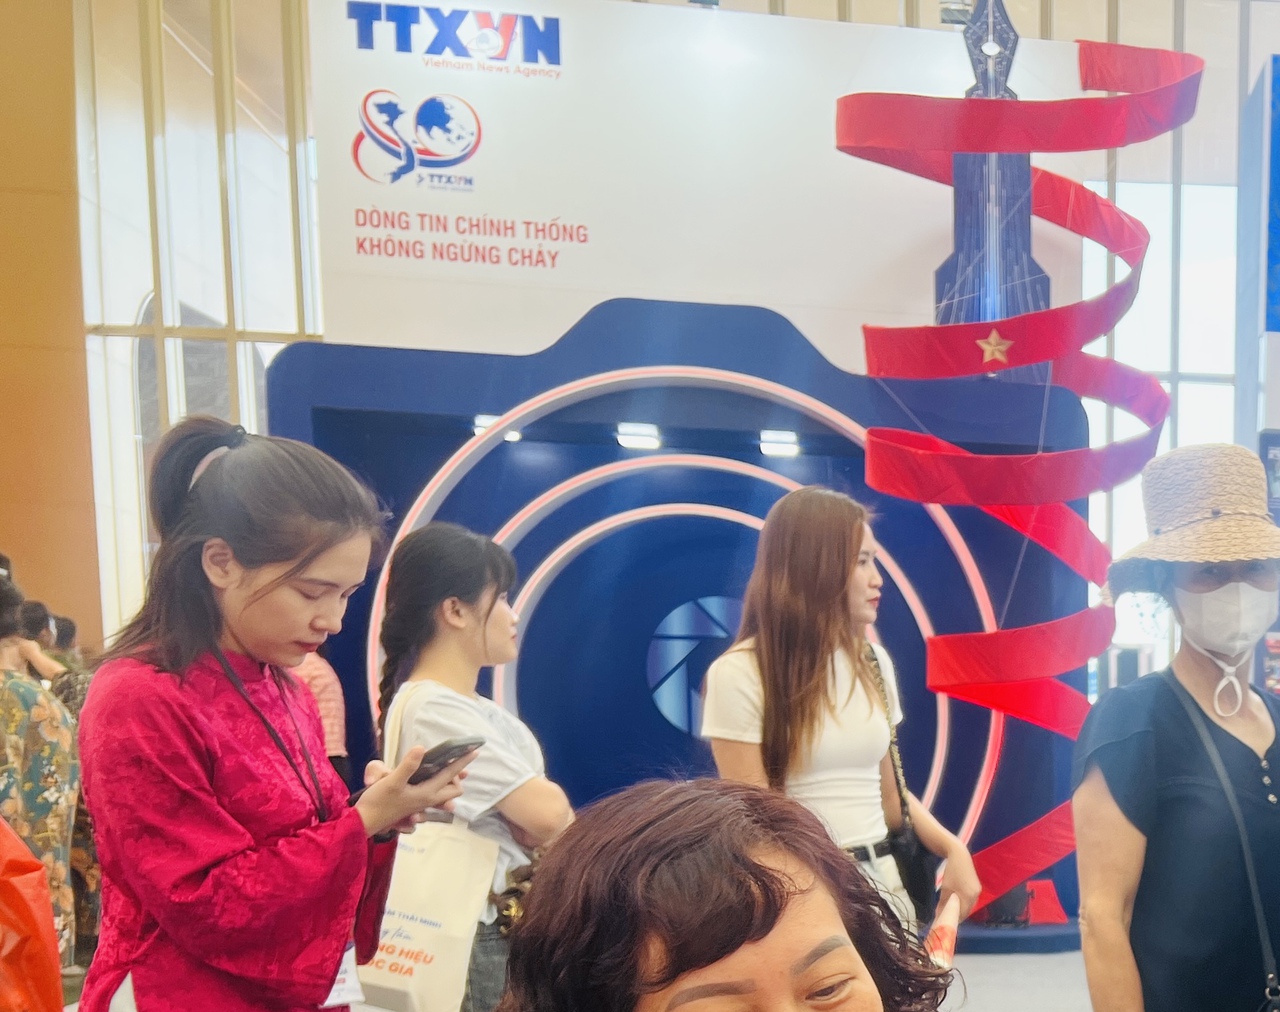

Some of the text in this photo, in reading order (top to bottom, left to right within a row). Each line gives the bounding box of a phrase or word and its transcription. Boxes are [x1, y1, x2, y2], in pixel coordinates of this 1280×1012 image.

[348, 1, 561, 66] TTXVN
[422, 57, 561, 80] Vietnam News Agency
[354, 206, 589, 243] DÒNG TIN CHÍNH THỐNG
[355, 234, 560, 268] KHÔNG NGỪNG CHẢY
[388, 962, 415, 977] GIA
[399, 946, 435, 965] HIỆU
